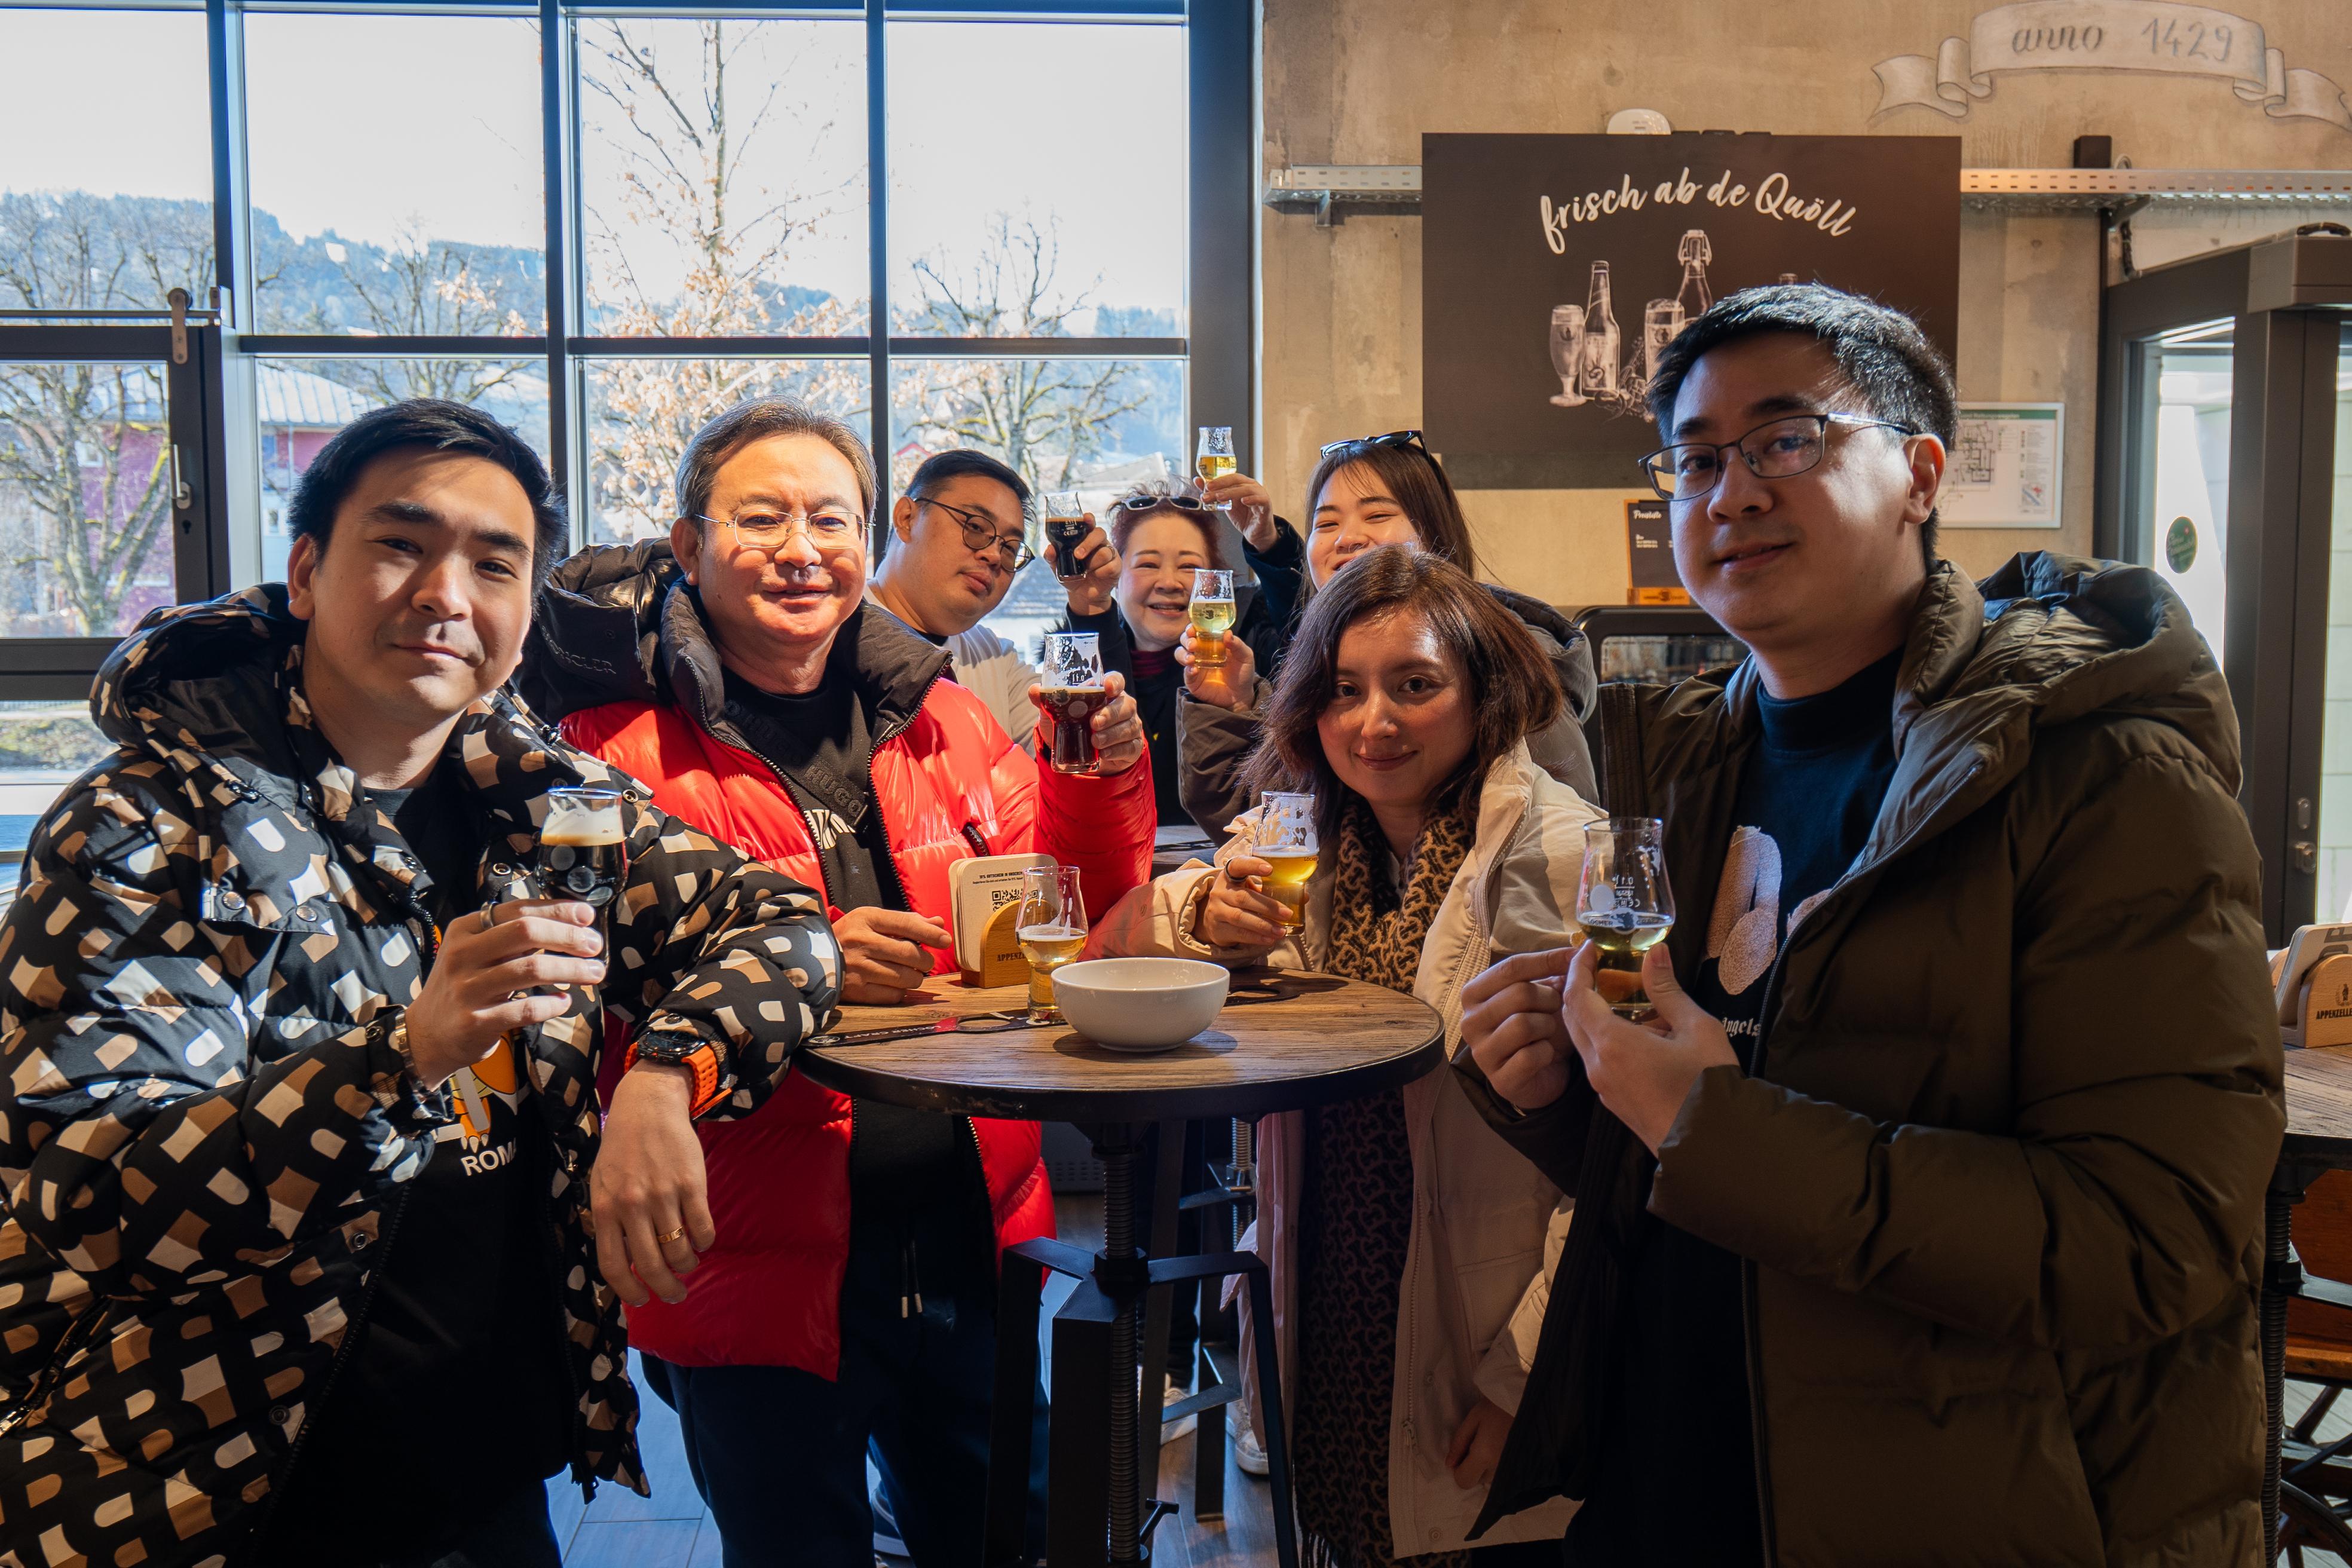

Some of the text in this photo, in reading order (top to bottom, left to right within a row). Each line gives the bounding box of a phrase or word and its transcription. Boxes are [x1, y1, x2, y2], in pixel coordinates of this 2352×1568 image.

[2012, 18, 2233, 62] anno 1429
[1540, 166, 1857, 255] frisch ab de Quöll
[892, 1025, 941, 1034] LOCHER
[460, 1138, 517, 1177] ROM
